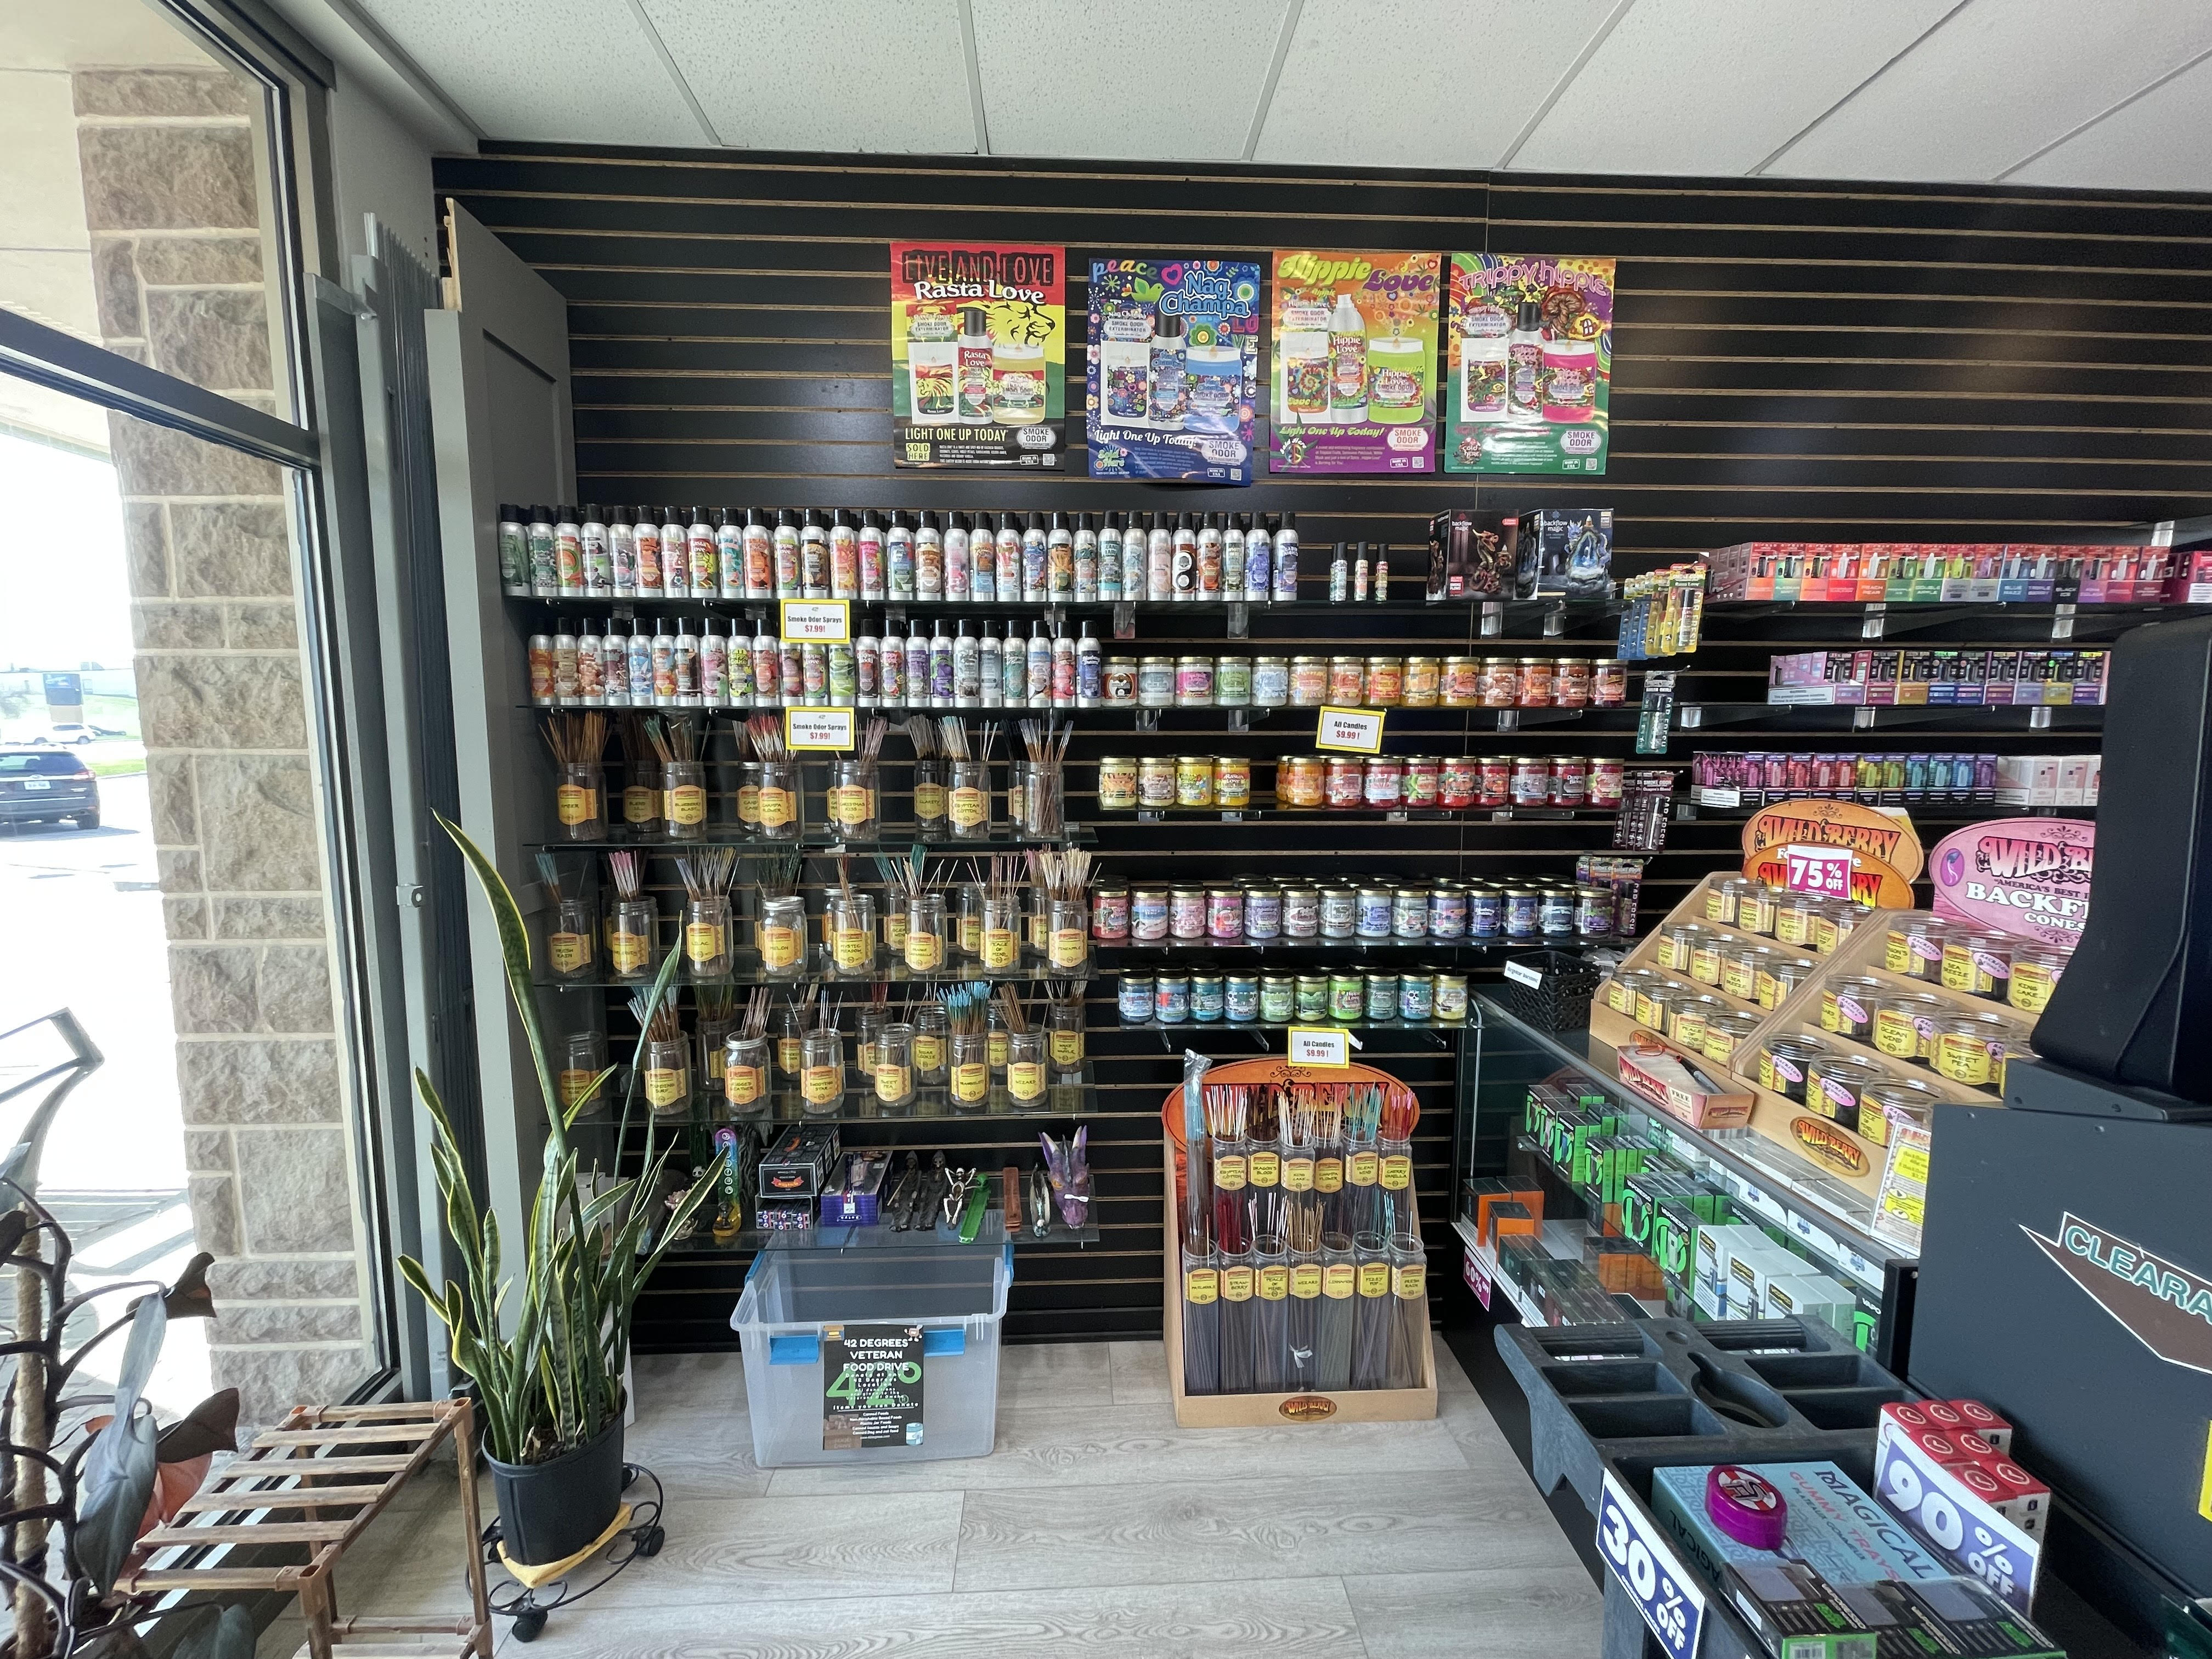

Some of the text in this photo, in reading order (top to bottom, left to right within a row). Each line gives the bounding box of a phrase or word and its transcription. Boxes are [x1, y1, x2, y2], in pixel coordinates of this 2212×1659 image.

[905, 254, 1051, 284] LIVE AND LOVE
[1092, 259, 1158, 283] peace
[1278, 254, 1372, 286] Hippie
[1185, 272, 1231, 300] Nag
[1363, 270, 1435, 292] Love
[914, 279, 1045, 304] Rasta Love
[1160, 294, 1250, 319] Champa
[1333, 335, 1361, 346] Hippie
[964, 351, 986, 360] Rasta
[1382, 369, 1409, 378] Hippie
[905, 428, 1006, 442] LIGHT ONE UP TODAY
[1094, 430, 1120, 442] Light
[1122, 430, 1143, 441] One
[1145, 432, 1161, 443] Up
[1279, 426, 1306, 435] Light
[1308, 427, 1328, 436] One
[1347, 427, 1385, 438] Today!
[1567, 431, 1595, 439] SMOKE
[1209, 441, 1239, 450] SMOKE
[1212, 449, 1236, 458] ODOR
[1976, 836, 2061, 878] WILD
[1826, 878, 1843, 890] OFF
[2055, 888, 2080, 897] BEST
[2018, 983, 2038, 991] KING
[1881, 1026, 1908, 1038] OCEAN
[1883, 1034, 1902, 1043] WIND
[1946, 1052, 1980, 1063] SWEET
[1952, 1060, 1970, 1068] PEA
[1671, 1089, 1691, 1102] FREE
[1661, 1207, 1689, 1232] VAPORESSO
[1466, 1261, 1481, 1293] 60%
[844, 1339, 909, 1347] 42 DEGREES
[850, 1351, 903, 1359] VETERAN
[843, 1362, 910, 1372] FOOD DRIVE
[1286, 1400, 1308, 1414] WILD
[1792, 1487, 1827, 1520] PLATEAUX
[1790, 1471, 1847, 1522] GUMMY
[1848, 1528, 1902, 1581] TRAYS
[1813, 1470, 1934, 1579] MAGICAL
[1968, 1551, 2015, 1595] OFF
[1656, 1602, 1685, 1651] OFF
